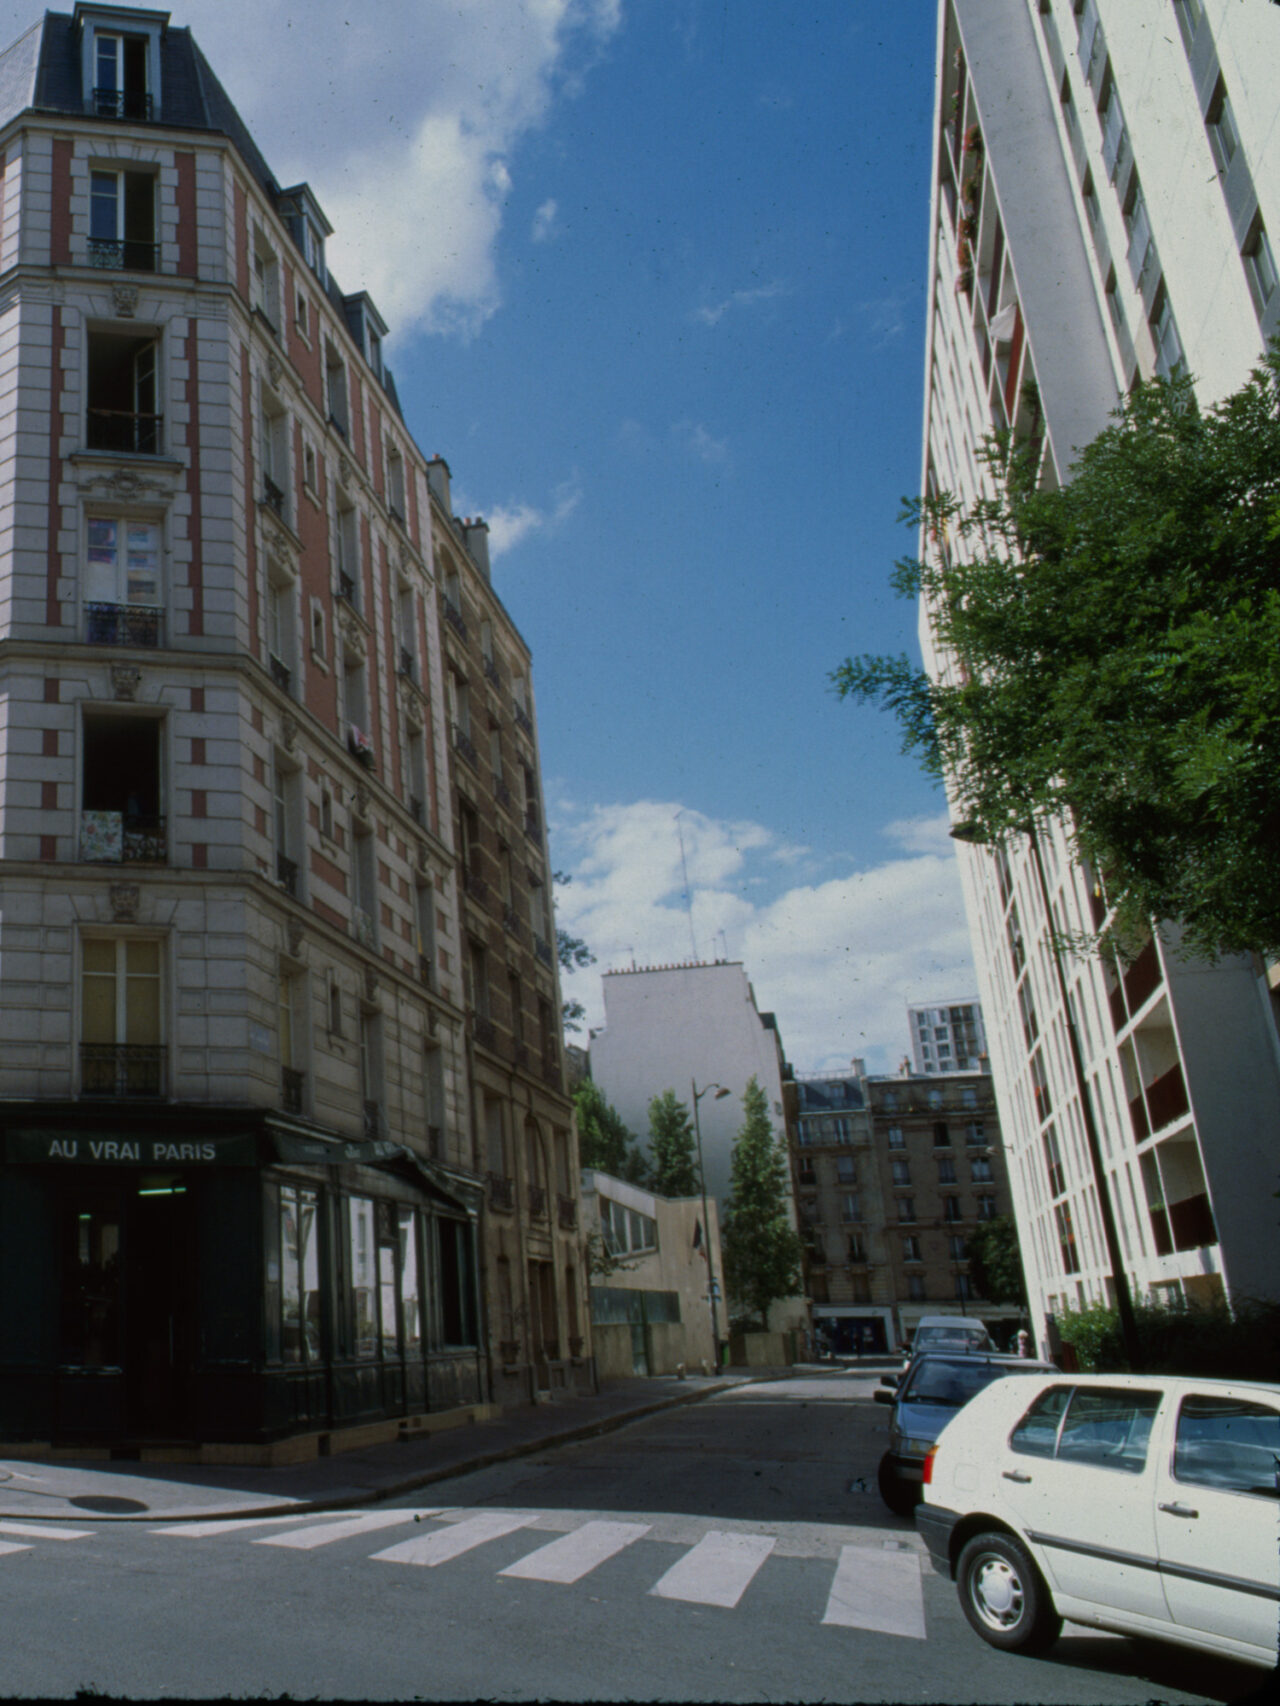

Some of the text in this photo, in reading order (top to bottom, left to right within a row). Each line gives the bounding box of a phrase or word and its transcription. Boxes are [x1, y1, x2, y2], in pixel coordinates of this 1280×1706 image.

[48, 1140, 216, 1160] AU VRAI PARIS
